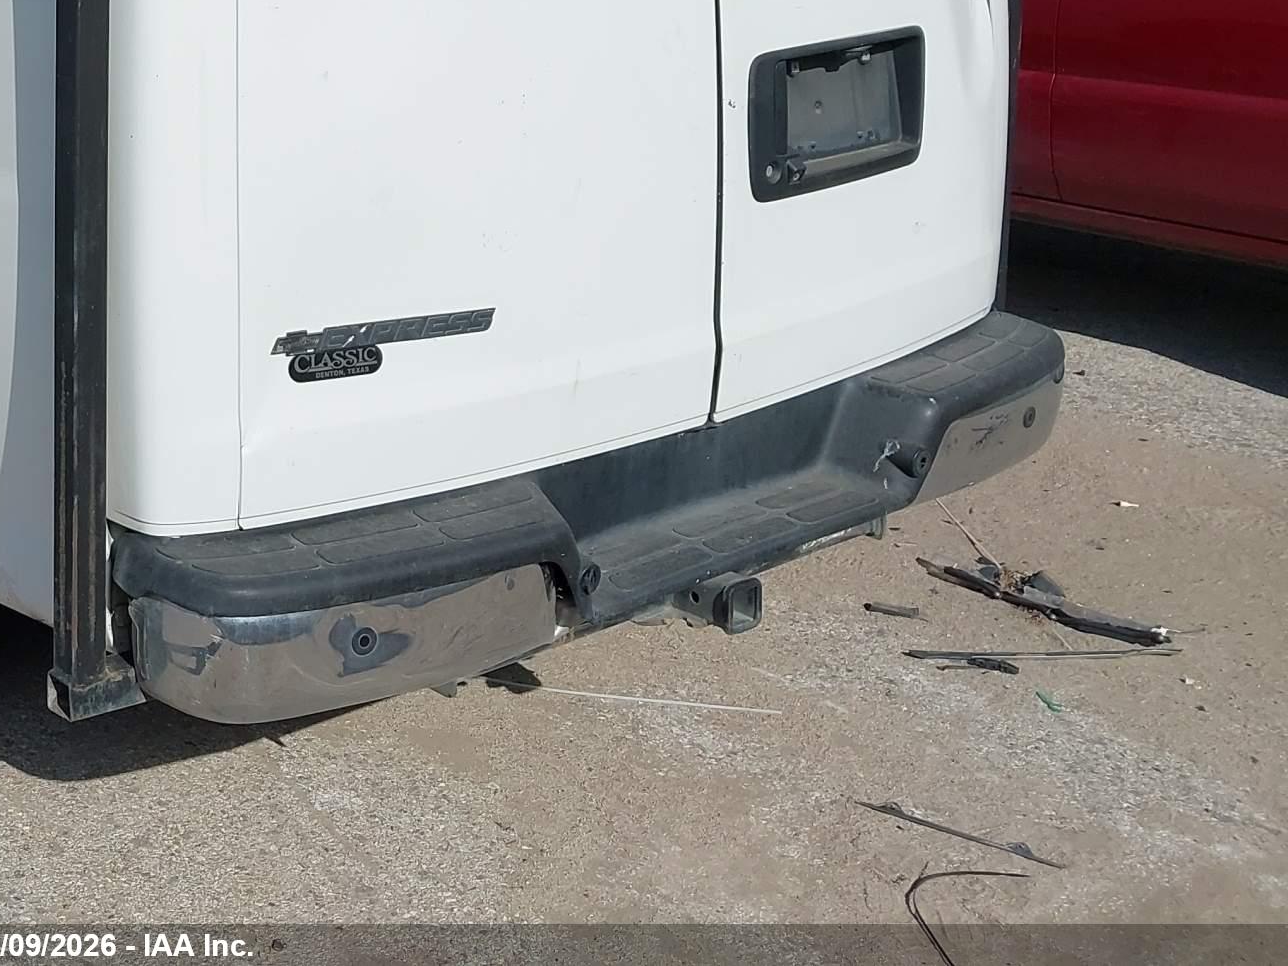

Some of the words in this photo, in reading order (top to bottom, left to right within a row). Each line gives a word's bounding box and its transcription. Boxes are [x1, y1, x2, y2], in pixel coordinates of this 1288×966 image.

[321, 308, 496, 350] EXPRESS
[294, 346, 377, 373] CLASSIC
[315, 367, 346, 379] DENTON,
[347, 366, 370, 375] TEXAS
